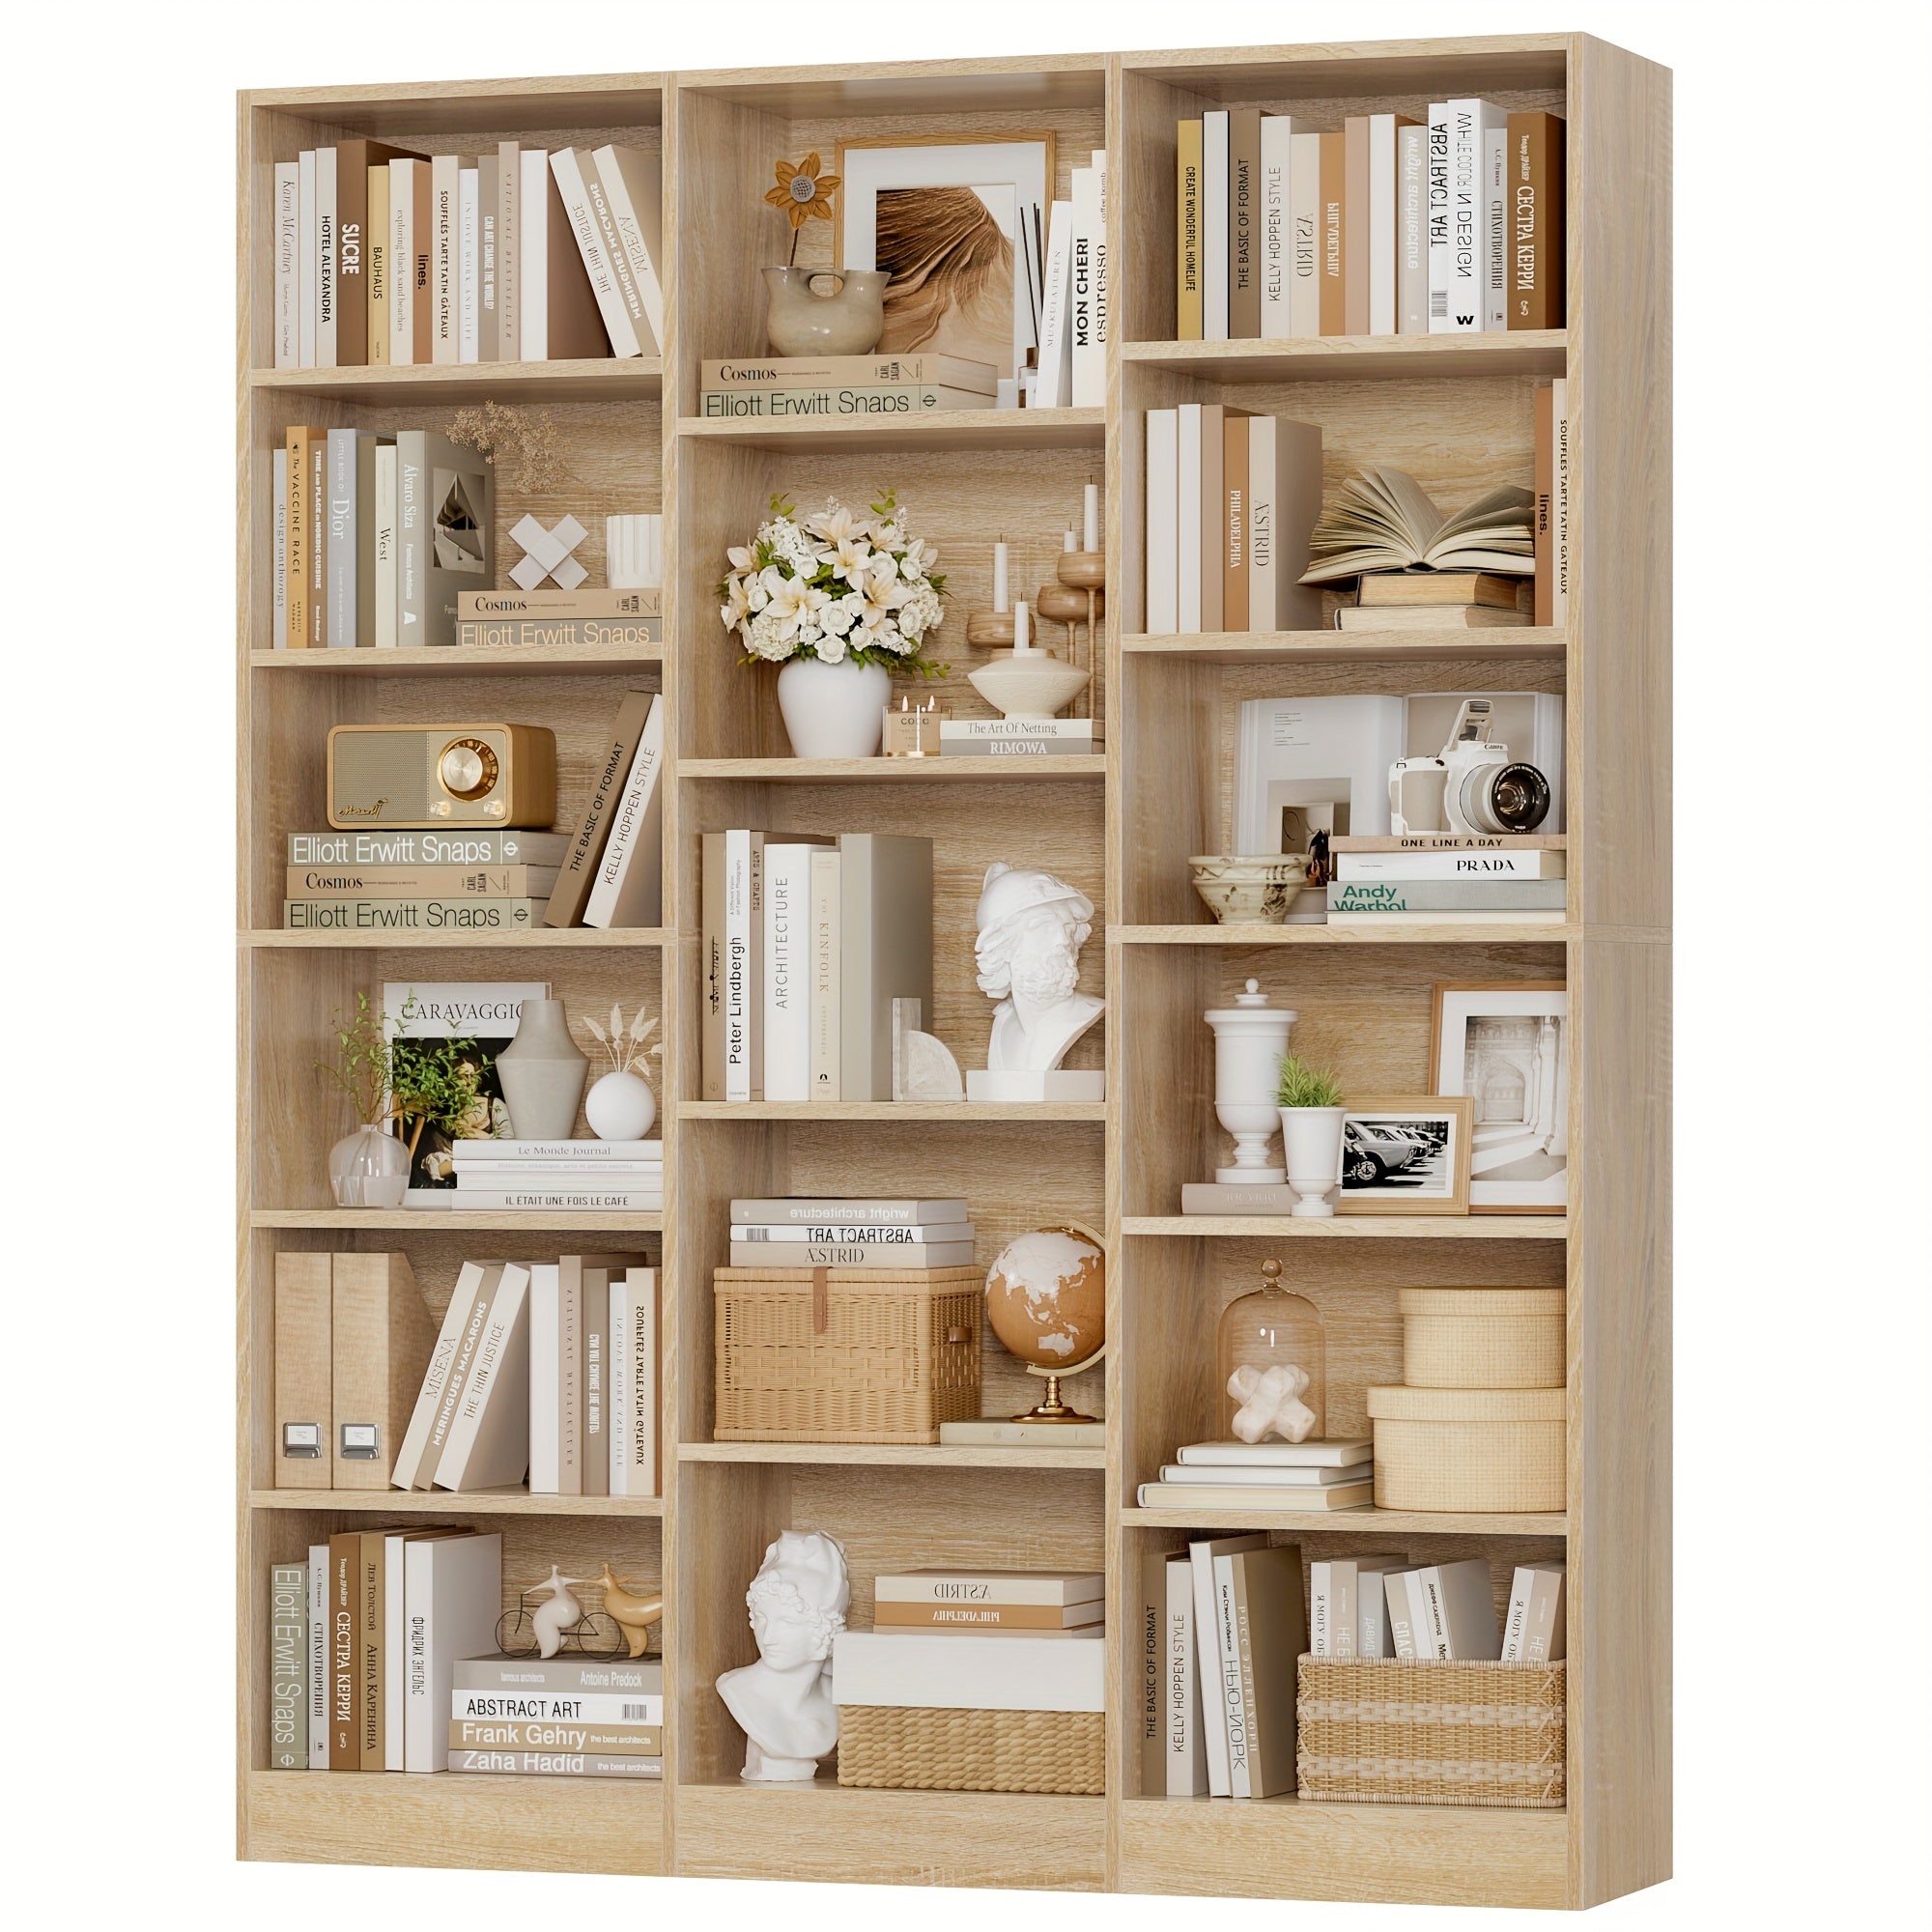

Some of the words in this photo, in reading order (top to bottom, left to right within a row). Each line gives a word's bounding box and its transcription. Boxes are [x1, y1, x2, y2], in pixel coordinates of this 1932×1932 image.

[283, 182, 295, 211] Karen
[1186, 167, 1195, 196] CREATE
[1238, 159, 1248, 206] FORMAT
[1269, 168, 1280, 204] STYLE
[395, 211, 404, 249] exploring
[1186, 199, 1195, 249] WONDERFUL
[1238, 212, 1248, 226] OF
[1517, 186, 1535, 242] СЕСТРА
[282, 216, 294, 272] McCartney
[341, 223, 360, 275] SUCRE
[1238, 231, 1249, 263] BASIC
[1269, 210, 1280, 258] HOPPEN
[1492, 201, 1502, 288] СТИХОТВОРЕНИЯ
[418, 255, 428, 289] lines.
[1077, 239, 1088, 294] CHERI
[1186, 252, 1195, 291] HOMELIFE
[1238, 268, 1248, 289] THE
[1269, 264, 1280, 300] KELLY
[1517, 244, 1535, 290] КЕРРИ
[322, 255, 330, 323] ALEXANDRA
[1097, 245, 1106, 342] espresso
[1077, 301, 1088, 346] MON
[721, 366, 777, 381] Cosmos
[880, 365, 889, 379] CARL
[890, 360, 900, 381] SAGAN
[705, 390, 762, 416] Elliott
[771, 393, 830, 416] Erwitt
[838, 391, 908, 414] Snaps
[405, 464, 416, 502] Álvaro
[331, 498, 350, 539] Dior
[405, 505, 416, 528] Siza
[1230, 490, 1241, 570] PHILADELPHIA
[1540, 495, 1548, 535] lines.
[380, 528, 390, 559] West
[475, 597, 526, 611] Cosmos
[621, 599, 630, 611] CARL
[630, 594, 639, 611] SAGAN
[461, 623, 514, 644] Elliott
[521, 622, 576, 644] Erwitt
[583, 622, 650, 644] Snaps
[968, 723, 985, 734] The
[987, 723, 1004, 734] Art
[1006, 723, 1020, 733] Of
[1021, 723, 1057, 735] Netting
[989, 741, 1048, 754] RIMOWA
[569, 848, 585, 872] THE
[581, 812, 598, 850] BASIC
[593, 792, 605, 811] OF
[600, 741, 624, 788] FORMAT
[603, 841, 624, 886] KELLY
[618, 790, 642, 843] HOPPEN
[635, 747, 655, 788] STYLE
[294, 836, 349, 863] Elliott
[356, 836, 414, 863] Erwitt
[422, 836, 491, 865] Snaps
[1458, 860, 1514, 870] PRADA
[306, 873, 362, 889] Cosmos
[477, 871, 488, 893] SAGAN
[1343, 884, 1397, 902] Andy
[291, 904, 348, 927] Elliott
[357, 904, 418, 926] Erwitt
[427, 903, 499, 928] Snaps
[1334, 899, 1407, 910] Warhol
[776, 878, 787, 1009] ARCHITECTURE
[820, 923, 829, 991] KINFOLK
[729, 938, 745, 1015] Lindbergh
[729, 1022, 741, 1064] Peter
[505, 1196, 513, 1206] IL
[545, 1196, 560, 1206] UNE
[563, 1196, 587, 1206] FOIS
[590, 1196, 602, 1206] LE
[482, 1321, 506, 1366] JUSTICE
[432, 1374, 463, 1446] MERINGUES
[458, 1300, 488, 1372] MACARONS
[471, 1363, 490, 1396] THIN
[464, 1394, 480, 1420] THE
[275, 1570, 301, 1618] Elliott
[336, 1612, 351, 1669] СЕСТРА
[412, 1617, 424, 1656] ФРИДРИХ
[1147, 1605, 1155, 1654] FORMAT
[1174, 1615, 1183, 1652] STYLE
[1337, 1627, 1350, 1644] НЕ
[275, 1625, 301, 1676] Erwitt
[1147, 1660, 1155, 1674] OF
[412, 1661, 424, 1694] ЭНГЕЛЬС
[581, 1670, 609, 1686] Antoine
[611, 1671, 642, 1688] Predock
[1147, 1679, 1155, 1712] BASIC
[1174, 1658, 1183, 1708] HOPPEN
[1237, 1605, 1249, 1647] РОСС
[1243, 1654, 1258, 1752] ЭЛЛЕНХОРН
[273, 1683, 301, 1743] Snaps
[337, 1674, 351, 1720] КЕРРИ
[468, 1699, 546, 1717] ABSTRACT
[553, 1702, 582, 1718] ART
[1225, 1660, 1246, 1770] НЬЮ-ЙОРК
[462, 1723, 519, 1743] Frank
[526, 1724, 586, 1749] Gehry
[603, 1735, 617, 1744] best
[617, 1736, 651, 1745] architects
[1147, 1717, 1155, 1739] THE
[1174, 1714, 1183, 1751] KELLY
[464, 1751, 515, 1771] Zaha
[524, 1751, 584, 1773] Hadid
[611, 1763, 626, 1772] best
[627, 1764, 661, 1773] architects
